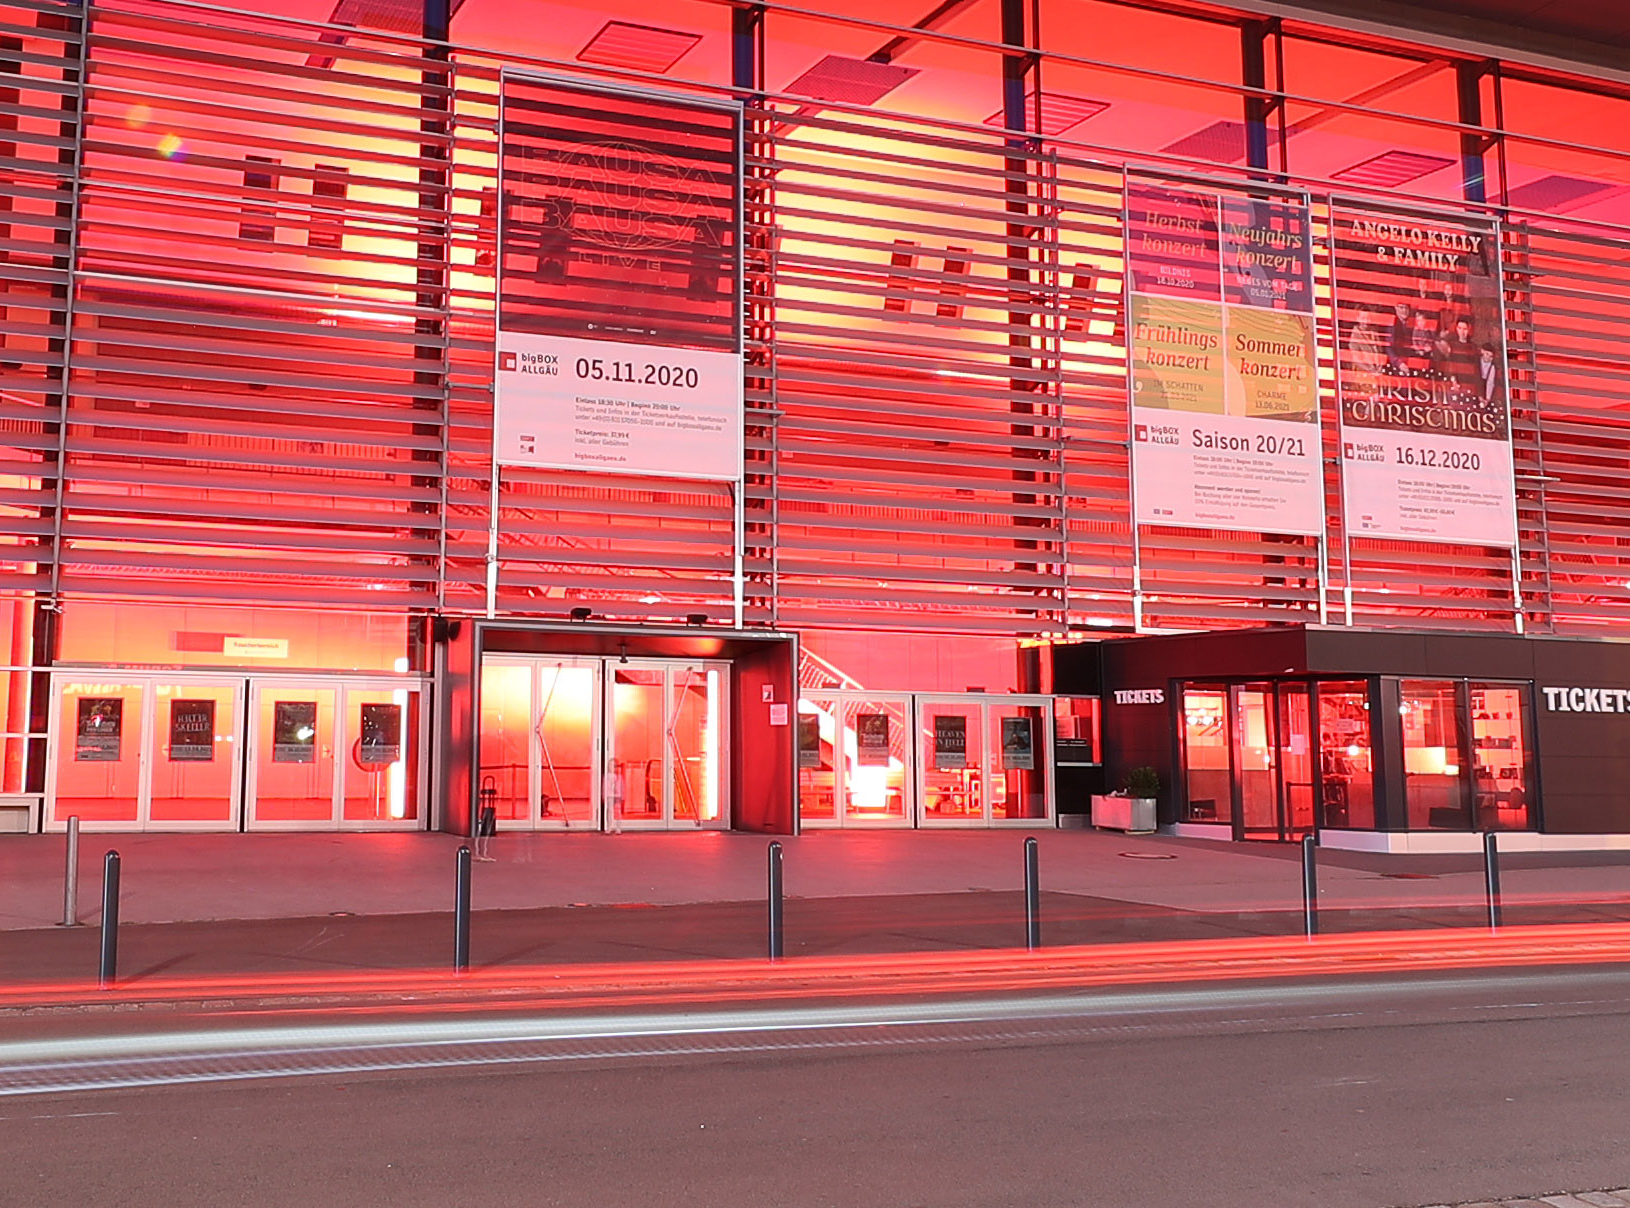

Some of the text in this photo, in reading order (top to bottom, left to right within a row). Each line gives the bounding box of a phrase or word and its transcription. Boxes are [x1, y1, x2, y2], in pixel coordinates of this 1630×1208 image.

[522, 198, 721, 249] BAUSA
[1145, 210, 1204, 234] Herbst
[1142, 233, 1206, 258] konzert
[1229, 222, 1303, 248] Neujahrs
[1350, 218, 1482, 254] ANGELO KELLY
[579, 252, 661, 271] LIVE
[1236, 246, 1298, 271] konzert
[1377, 246, 1459, 272] & FAMILY
[1135, 322, 1218, 350] Frühlings
[1235, 333, 1302, 358] Sommer
[521, 352, 558, 364] bigBOX
[521, 364, 558, 376] ALLGÄU
[1146, 346, 1211, 371] konzert
[1240, 358, 1302, 380] konzert
[576, 358, 699, 388] 05.11.2020
[1151, 426, 1179, 435] bigBOX
[1192, 429, 1306, 456] Saison 20/21
[1357, 444, 1385, 453] bigBOX
[1396, 446, 1481, 471] 16.12.2020
[1113, 689, 1165, 704] TICKETS
